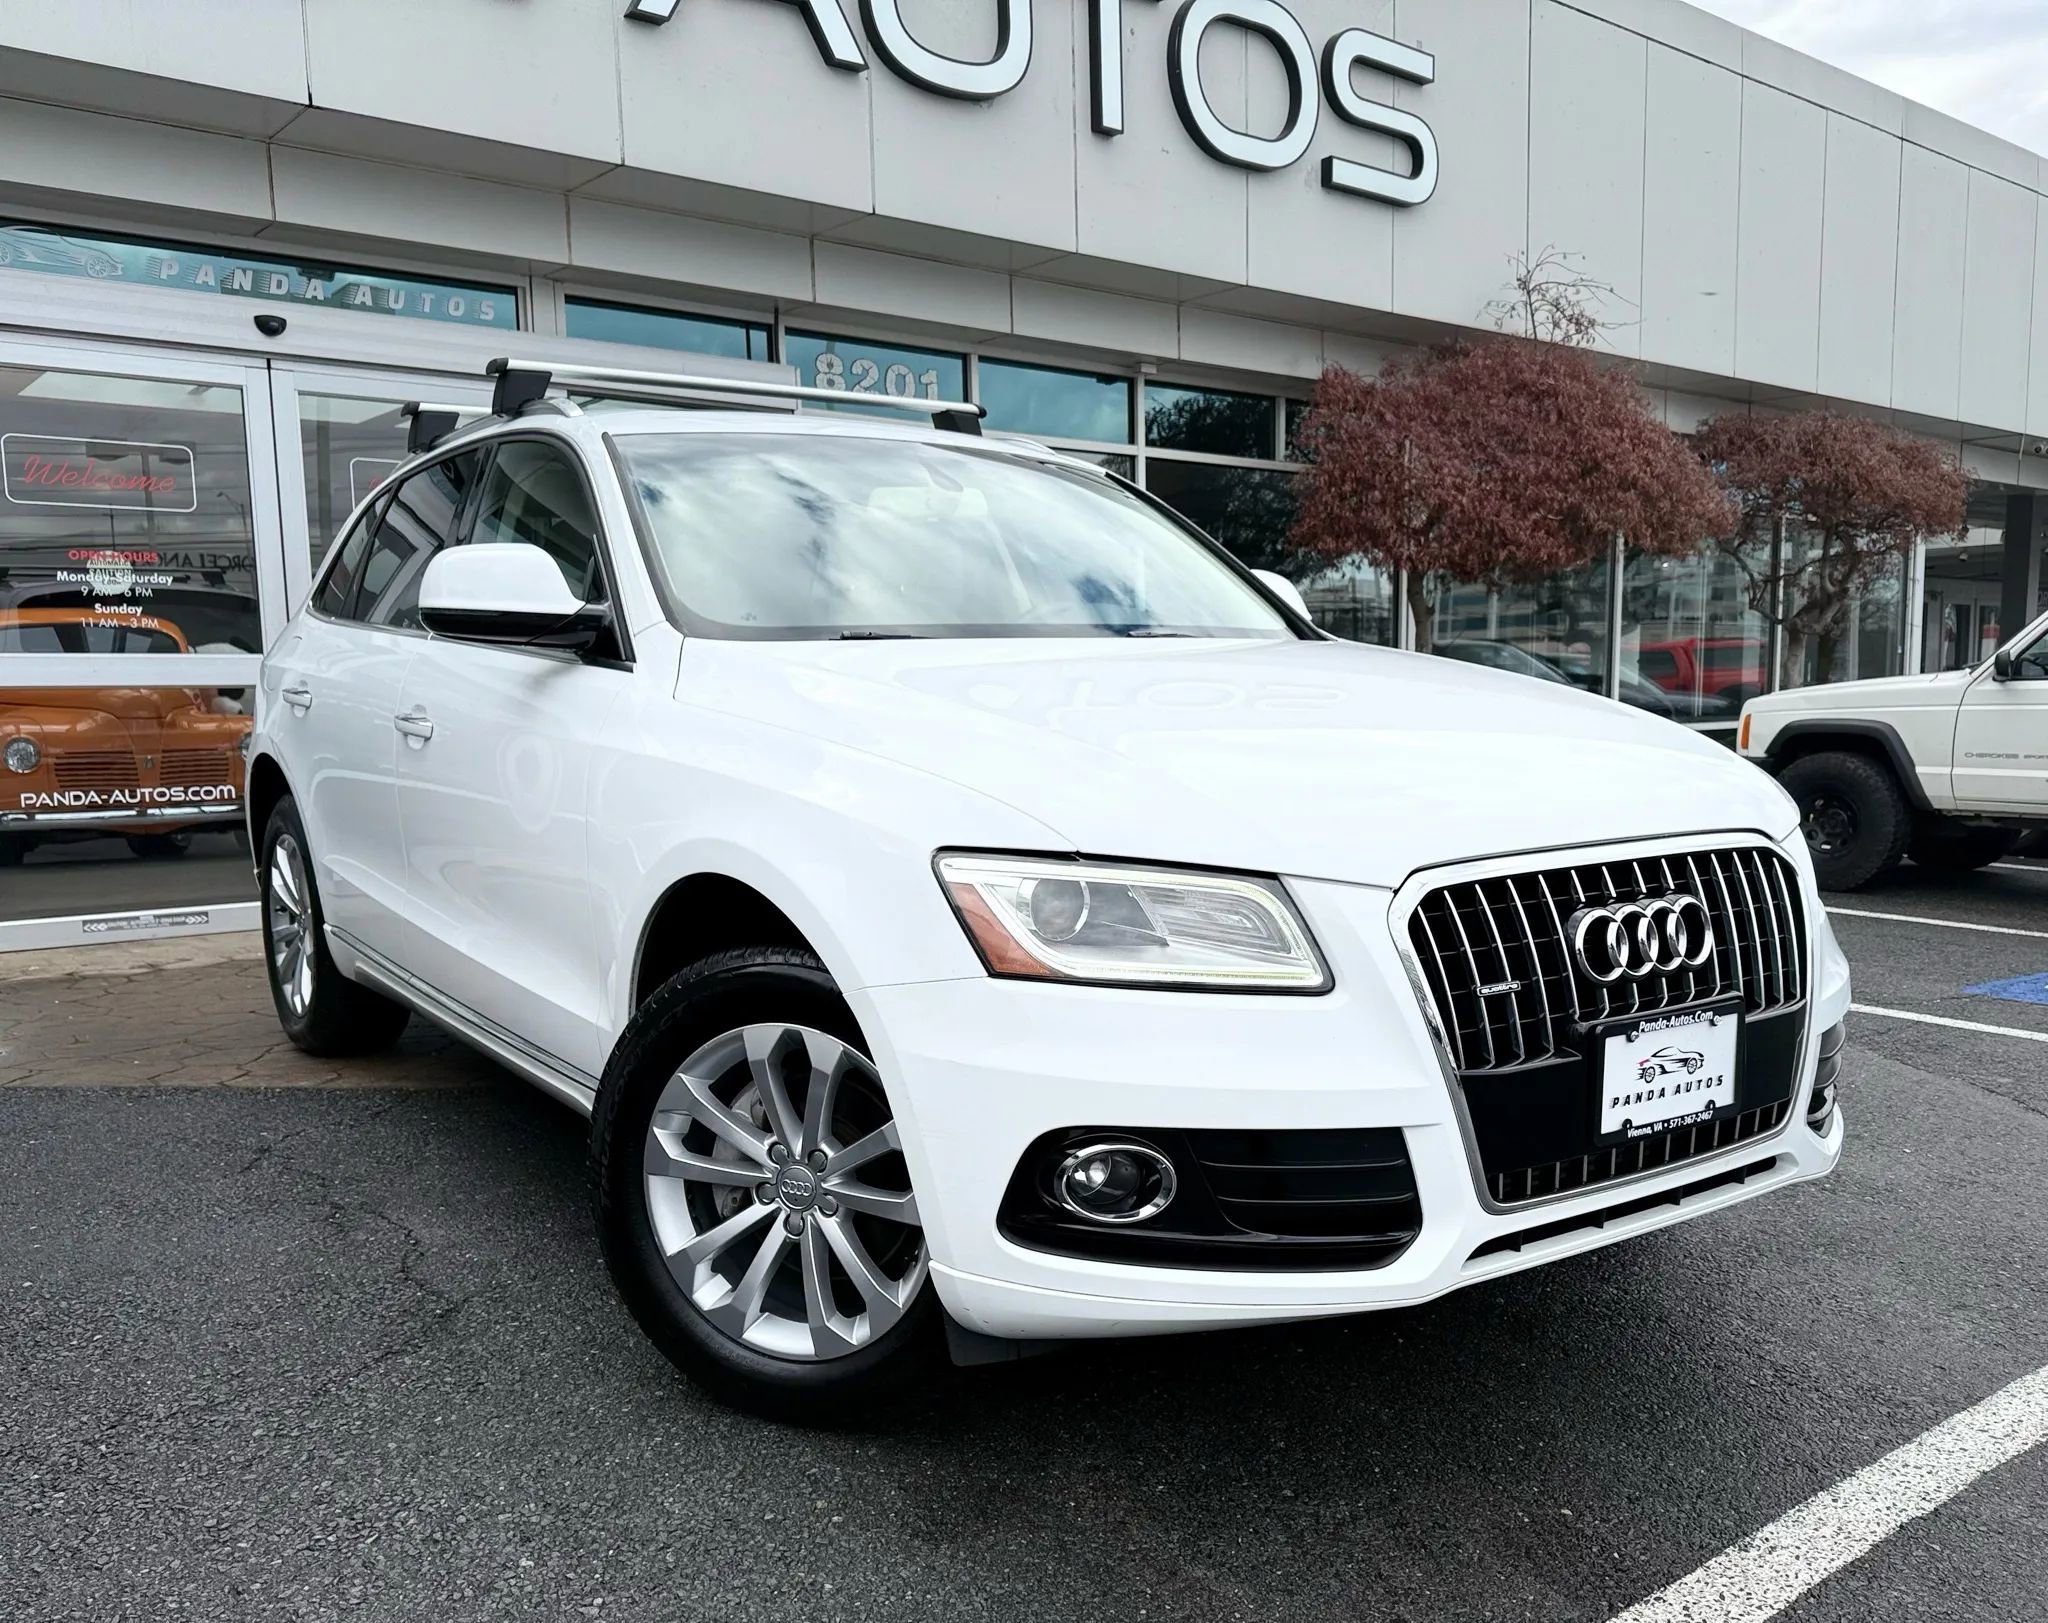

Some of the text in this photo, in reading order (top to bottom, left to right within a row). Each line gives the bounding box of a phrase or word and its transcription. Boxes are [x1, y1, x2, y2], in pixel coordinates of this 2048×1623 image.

[158, 257, 496, 322] PANDA AUTOS
[815, 353, 939, 400] 8201
[23, 454, 177, 493] Welcome
[56, 570, 173, 586] Monday-Saturday
[80, 585, 153, 597] 9 AM 6 PM
[94, 603, 143, 616] Sunday
[81, 617, 94, 628] 11
[99, 618, 119, 628] AM
[130, 618, 138, 628] 3
[141, 619, 159, 629] PM
[1638, 1011, 1714, 1033] Panda-Autos.Com
[1611, 1075, 1724, 1109] PANDA AUTOS
[1627, 1110, 1714, 1139] Vienna, VA 571-367-2467
